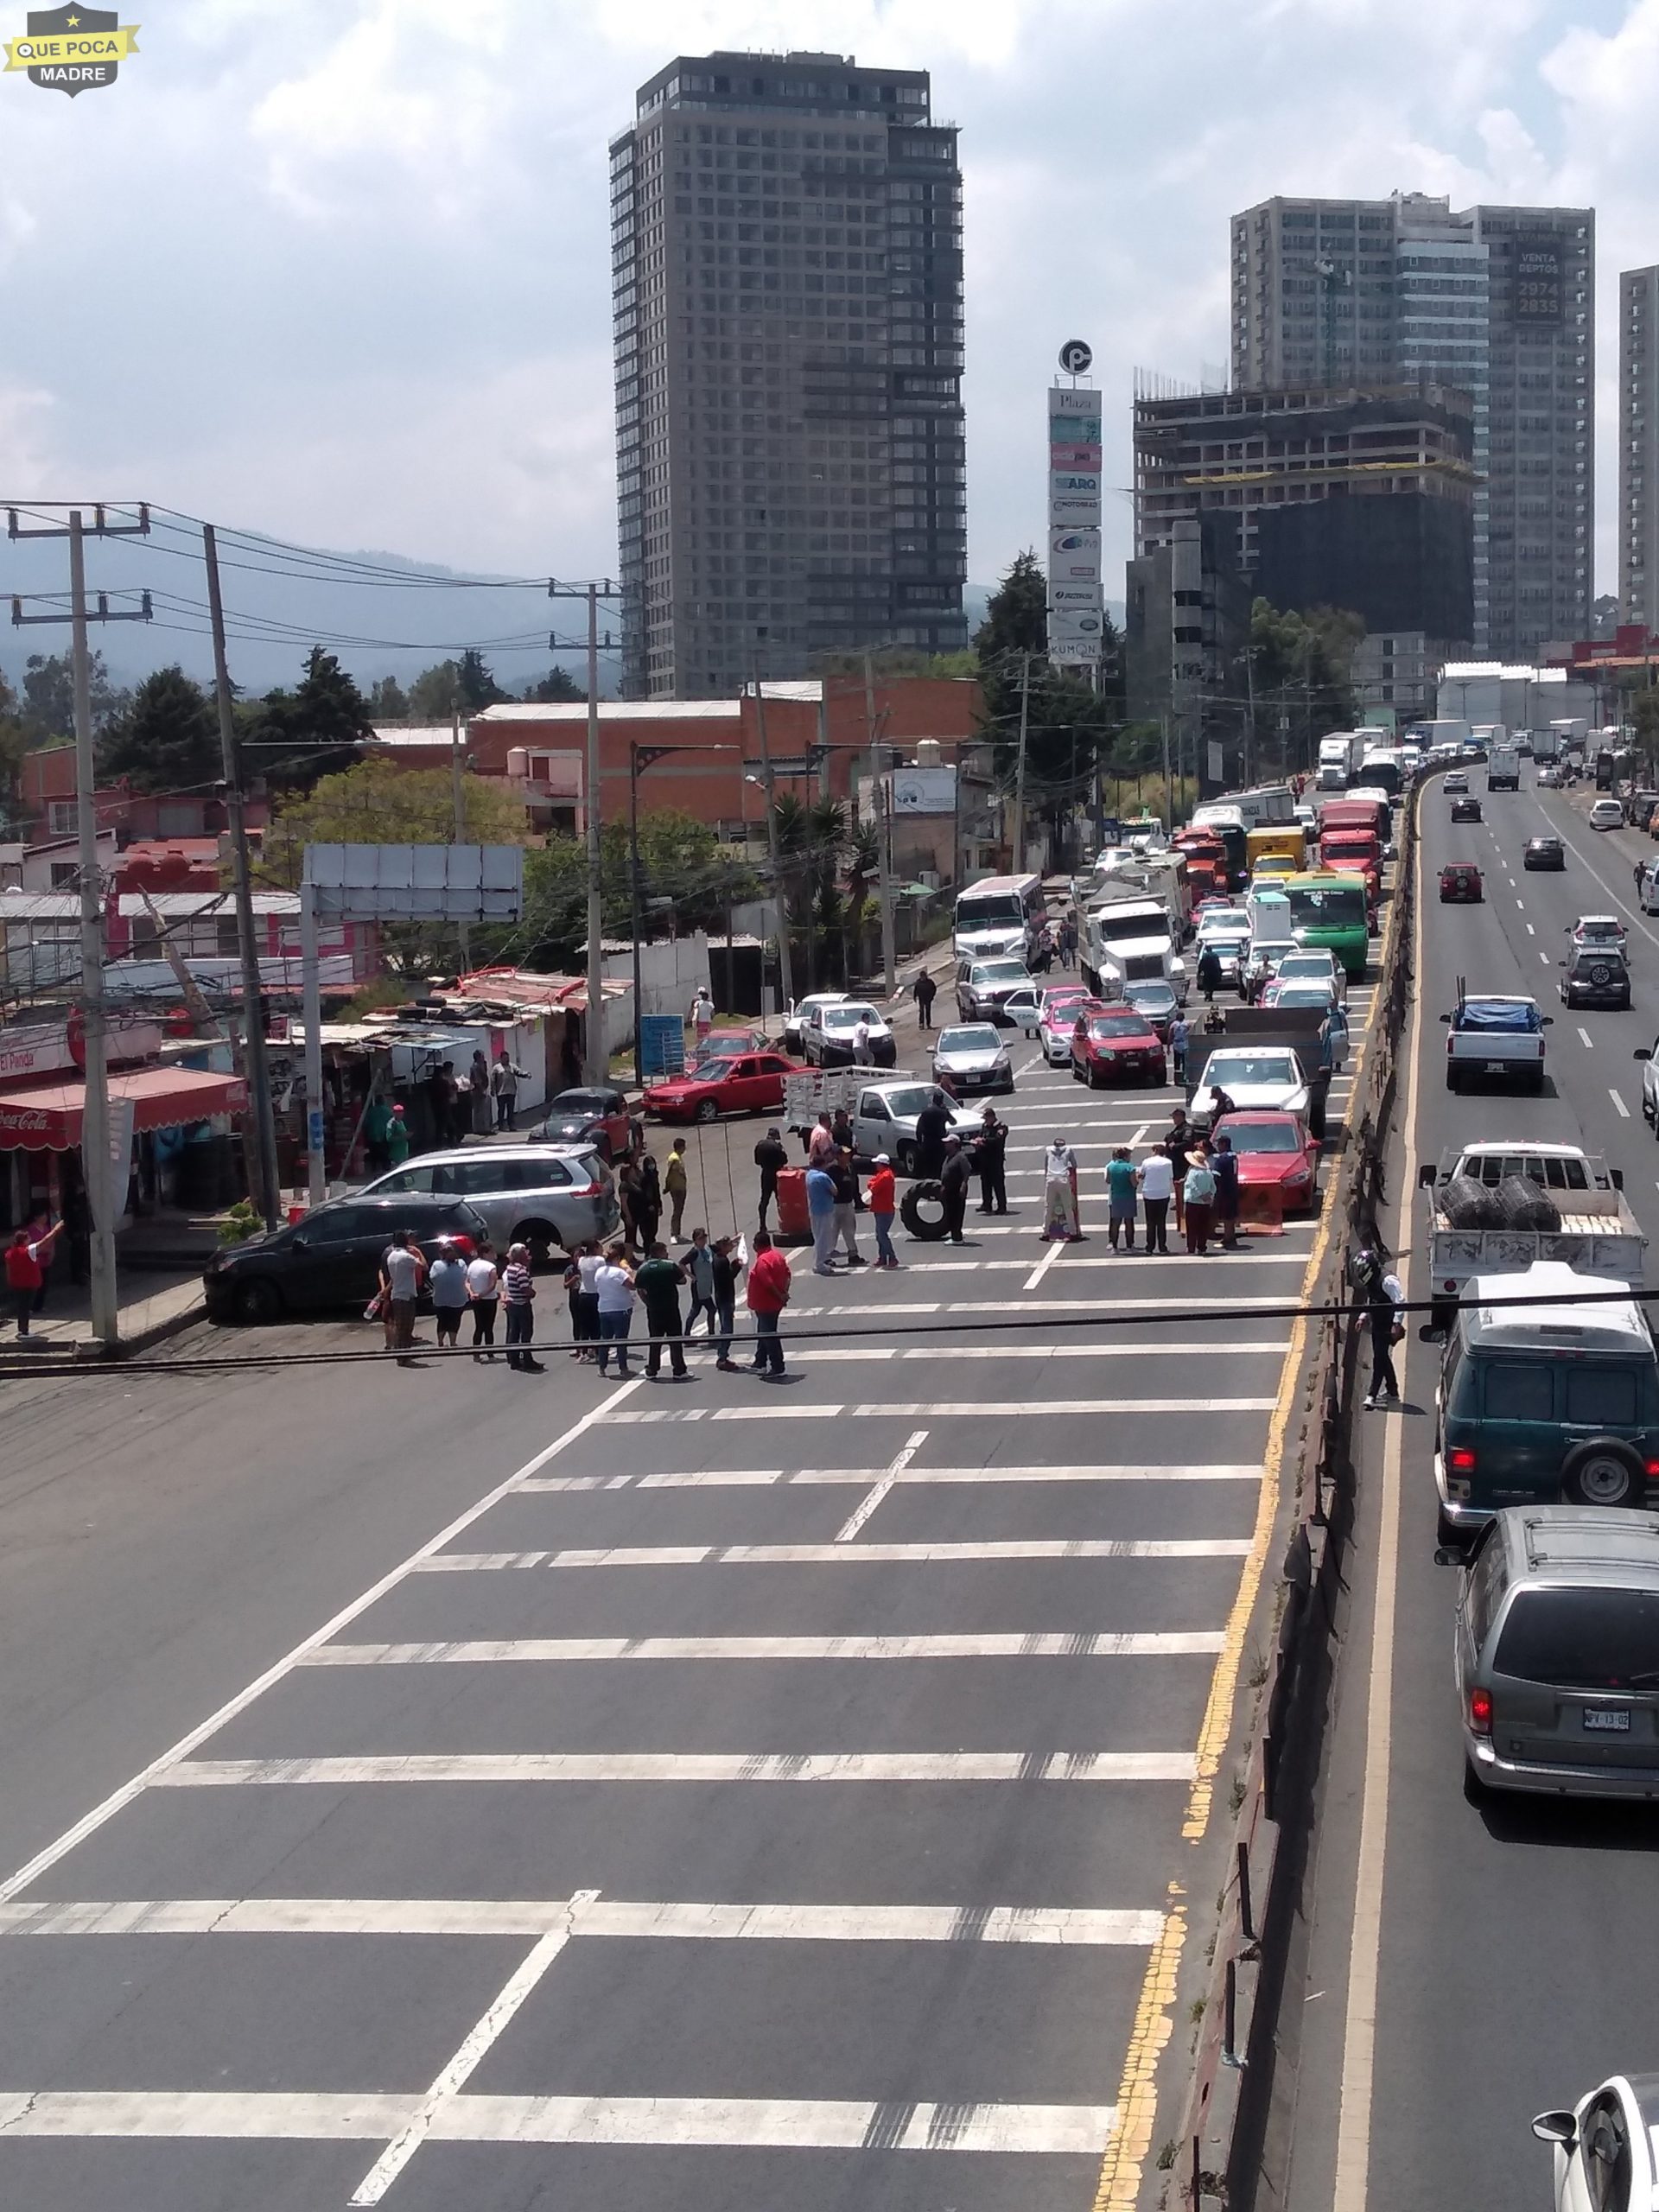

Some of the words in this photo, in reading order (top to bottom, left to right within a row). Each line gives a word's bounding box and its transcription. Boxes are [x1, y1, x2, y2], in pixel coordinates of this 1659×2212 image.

[1522, 253, 1555, 263] VENTA
[1519, 282, 1559, 296] 2974
[1060, 395, 1091, 408] Plaza
[1051, 643, 1096, 656] KUMON
